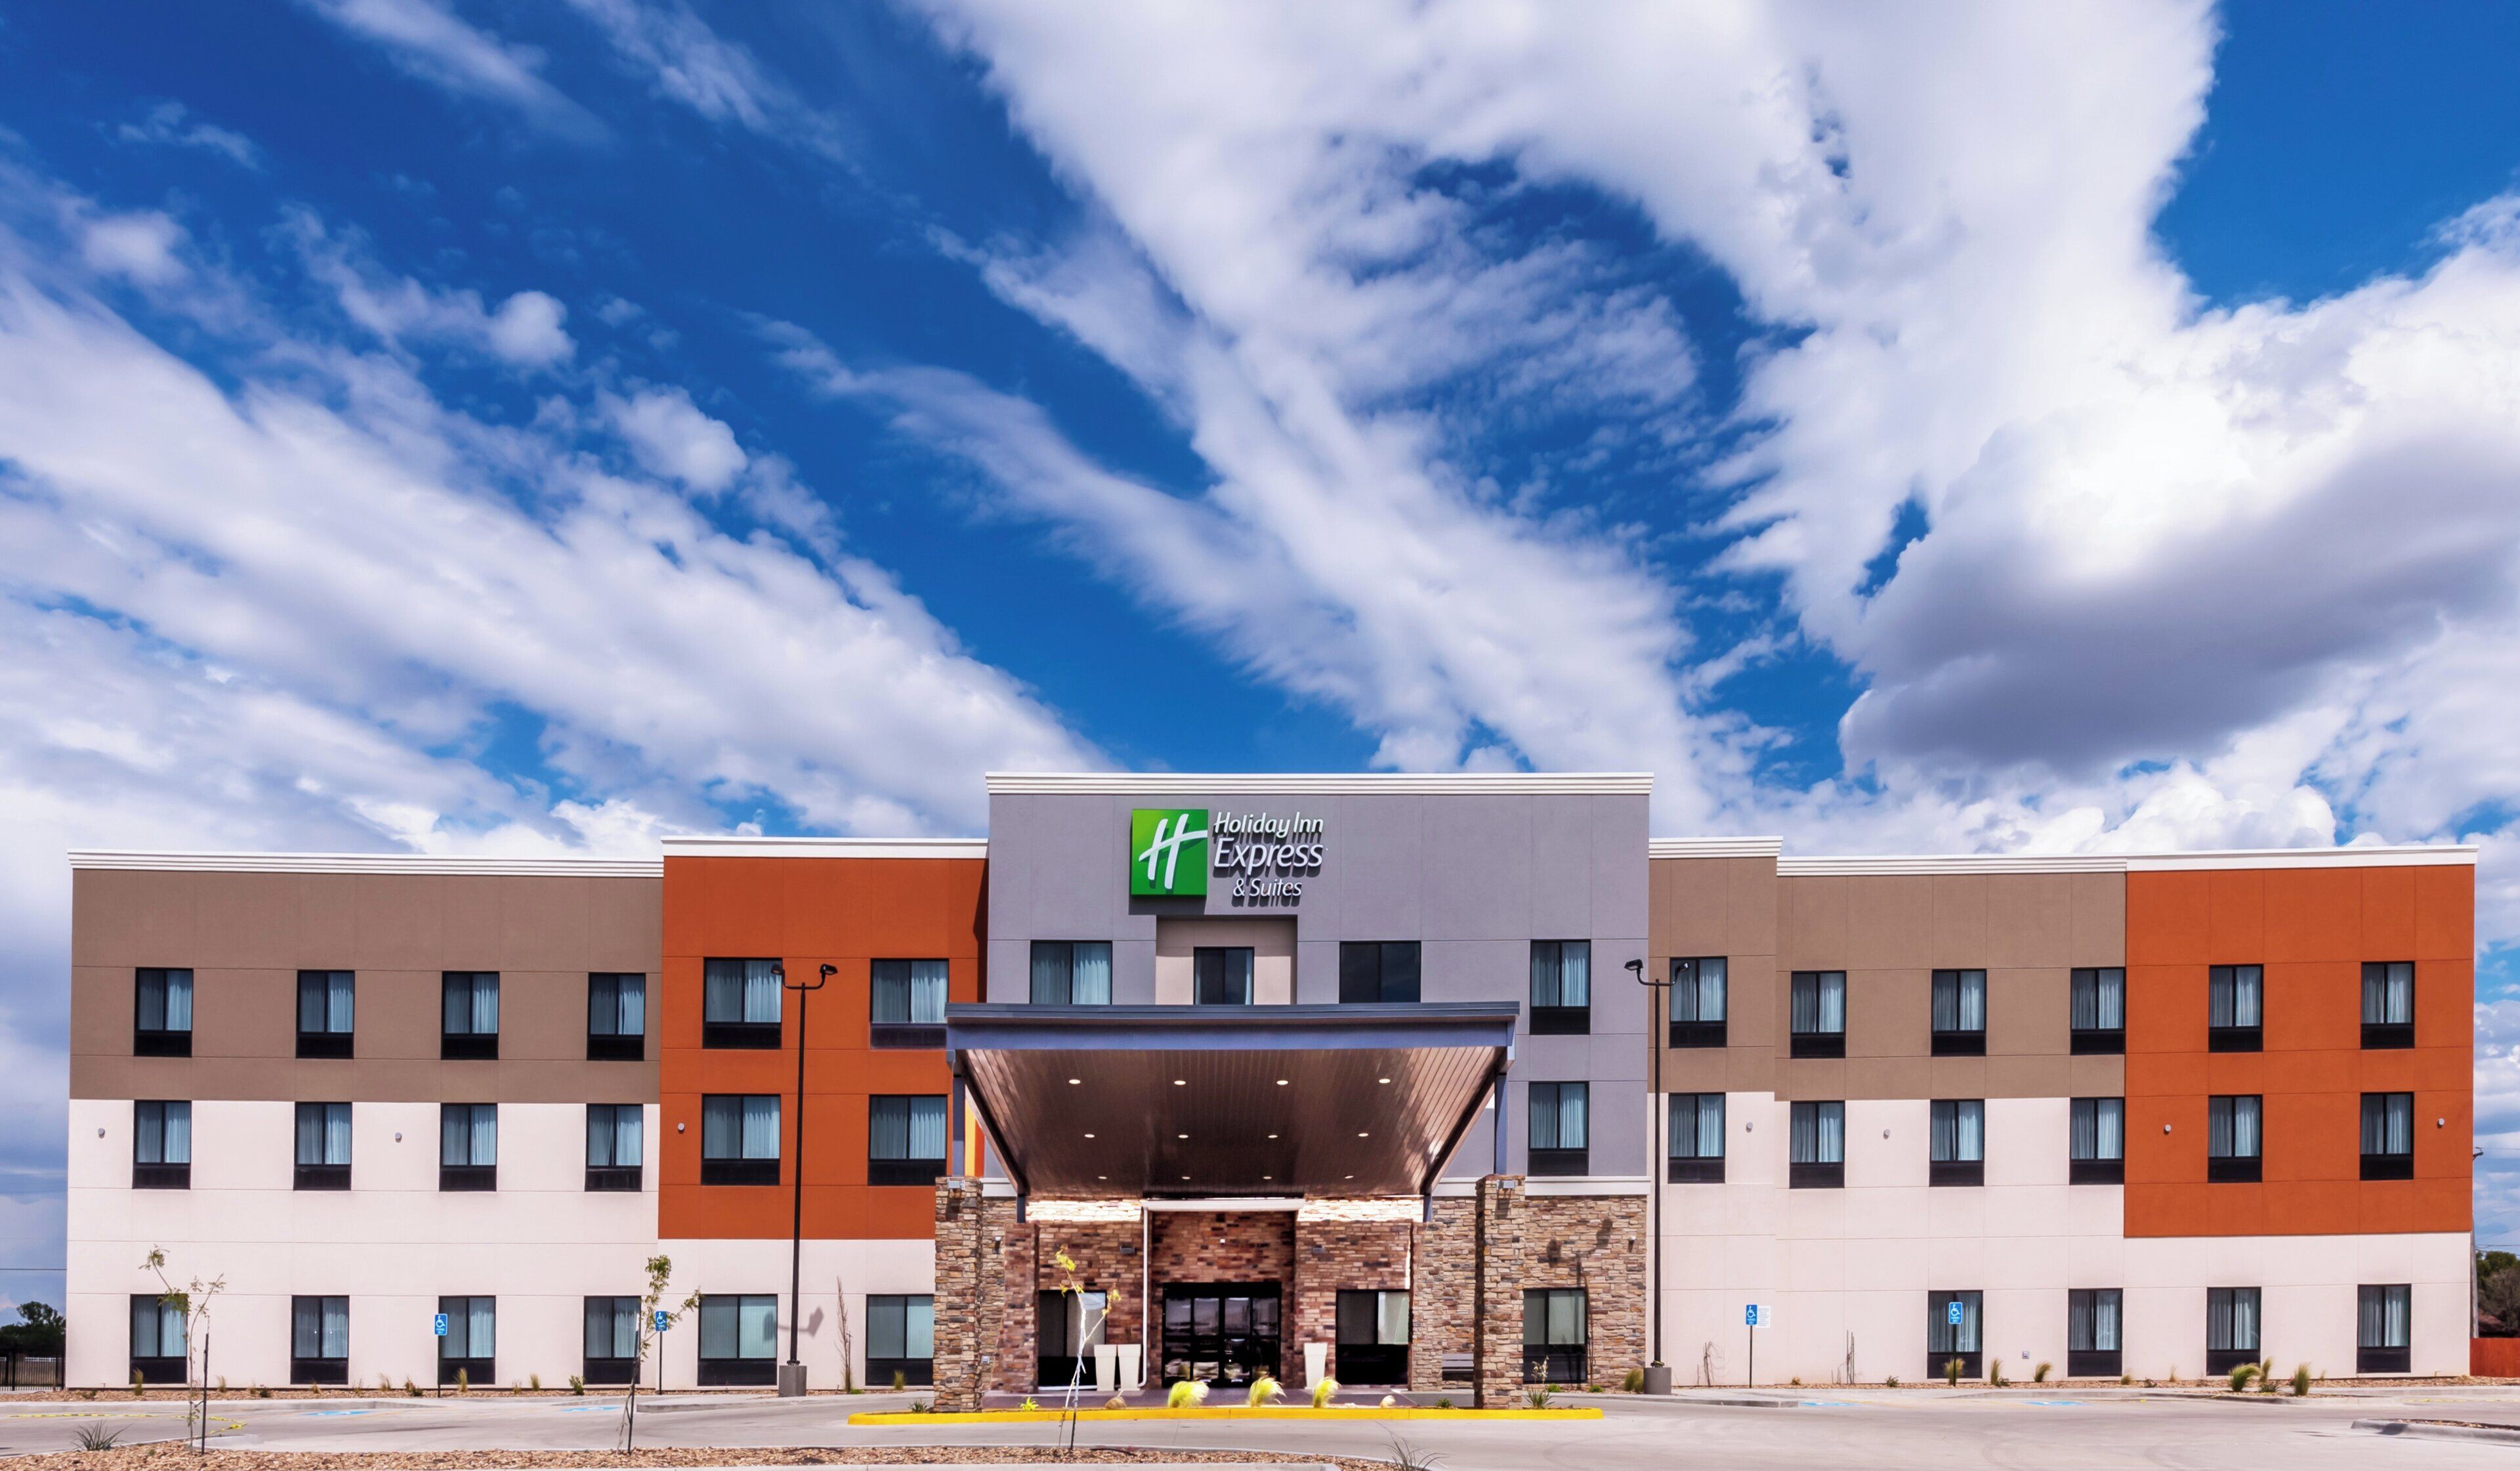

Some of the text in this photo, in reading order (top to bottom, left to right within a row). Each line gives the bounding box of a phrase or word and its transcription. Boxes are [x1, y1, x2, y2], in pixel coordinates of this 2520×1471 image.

[1213, 811, 1324, 838] Holiday Inn
[1214, 838, 1324, 876] Express
[1232, 878, 1303, 897] & Suites
